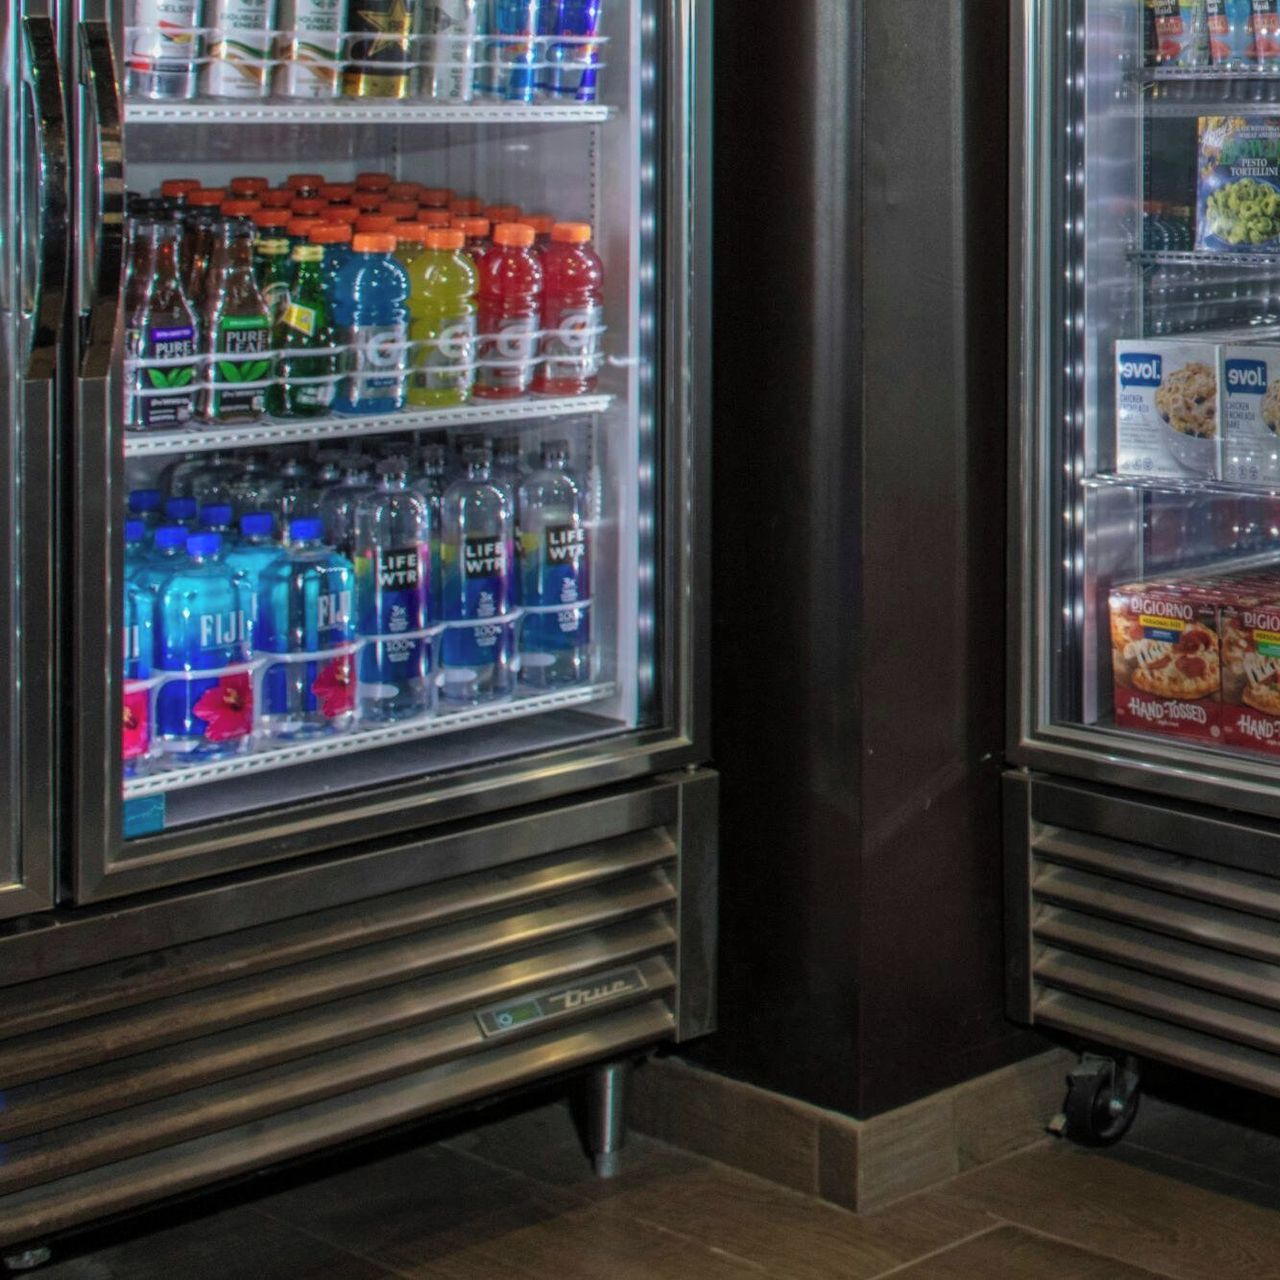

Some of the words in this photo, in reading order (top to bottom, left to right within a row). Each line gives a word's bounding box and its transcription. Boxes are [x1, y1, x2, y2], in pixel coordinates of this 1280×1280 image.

[1241, 158, 1268, 167] PESTO
[1231, 166, 1279, 176] TORTELLINI
[226, 330, 265, 343] PURE
[155, 342, 191, 355] PURE
[226, 342, 265, 354] LEAF
[1225, 402, 1249, 411] CHICKEN
[549, 530, 585, 546] LIFE
[465, 542, 503, 559] LIFE
[549, 545, 586, 560] WTR
[380, 553, 417, 572] LIFE
[465, 557, 505, 574] WTR
[379, 570, 418, 587] WTR
[1131, 596, 1193, 620] DIGIORNO
[200, 610, 244, 647] FIJI
[1129, 697, 1207, 724] HAND-TOSSED
[550, 980, 634, 1008] True
